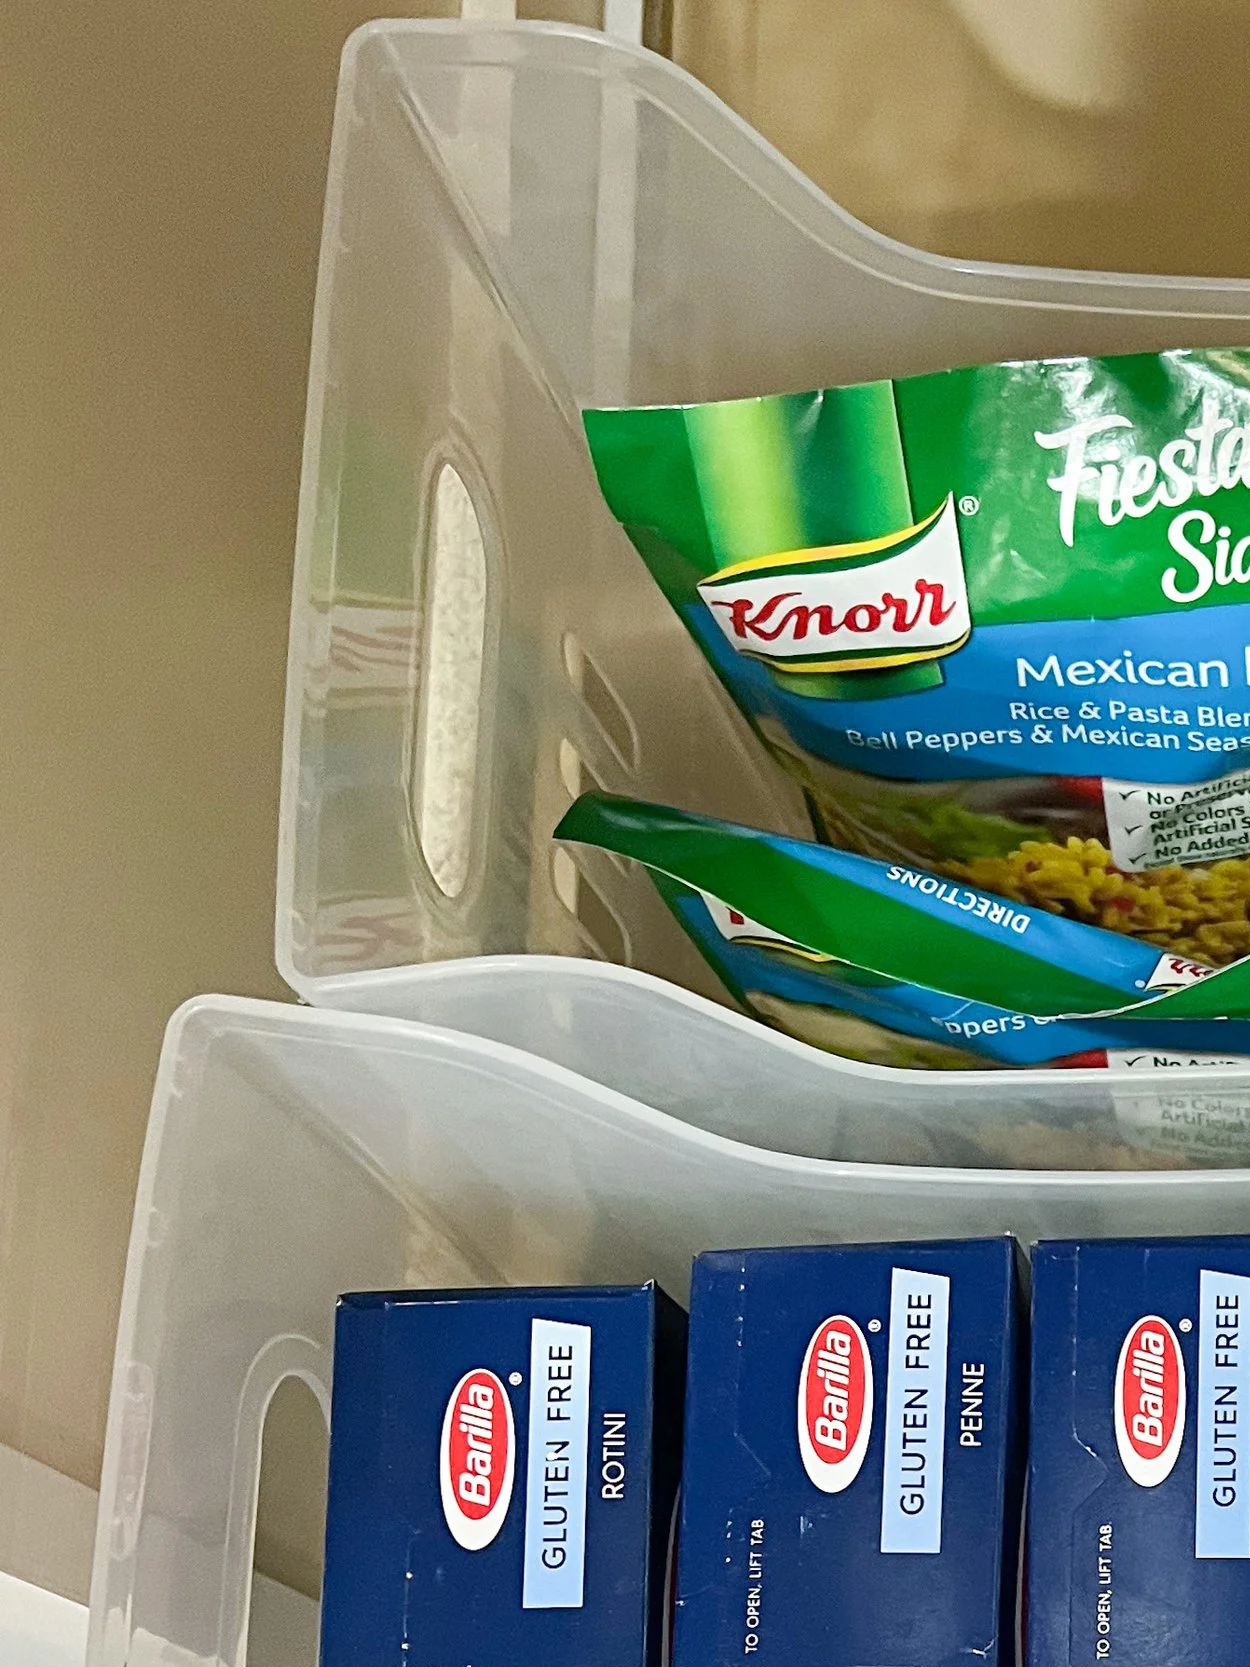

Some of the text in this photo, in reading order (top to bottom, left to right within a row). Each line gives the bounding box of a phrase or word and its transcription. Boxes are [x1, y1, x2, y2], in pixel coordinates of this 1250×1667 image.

[713, 579, 955, 641] Knorr
[1016, 650, 1228, 688] Mexican
[846, 729, 897, 750] Bell
[907, 726, 1023, 755] Peppers
[1031, 725, 1053, 744] &
[1062, 725, 1180, 750] Mexican
[1009, 702, 1069, 721] Rice
[1079, 702, 1100, 720] &
[1110, 701, 1190, 725] Pasta
[1148, 792, 1174, 806] No
[1153, 817, 1236, 846] Artificial
[1183, 805, 1245, 824] Colors
[1187, 832, 1249, 853] Added
[886, 866, 1031, 934] DIRECTIONS
[815, 1330, 851, 1451] Barilla
[900, 1293, 932, 1515] GLUTEN FREE
[960, 1362, 985, 1447] PENNE
[1133, 1330, 1164, 1447] Barilla
[1213, 1294, 1239, 1507] GLUTEN FREE
[458, 1383, 494, 1507] Barilla
[542, 1346, 572, 1569] GLUTEN FREE
[601, 1413, 626, 1499] ROTINI
[745, 1519, 765, 1654] TO OPEN, LIFT TAB
[1097, 1555, 1113, 1660] TO OPEN, LIFT
